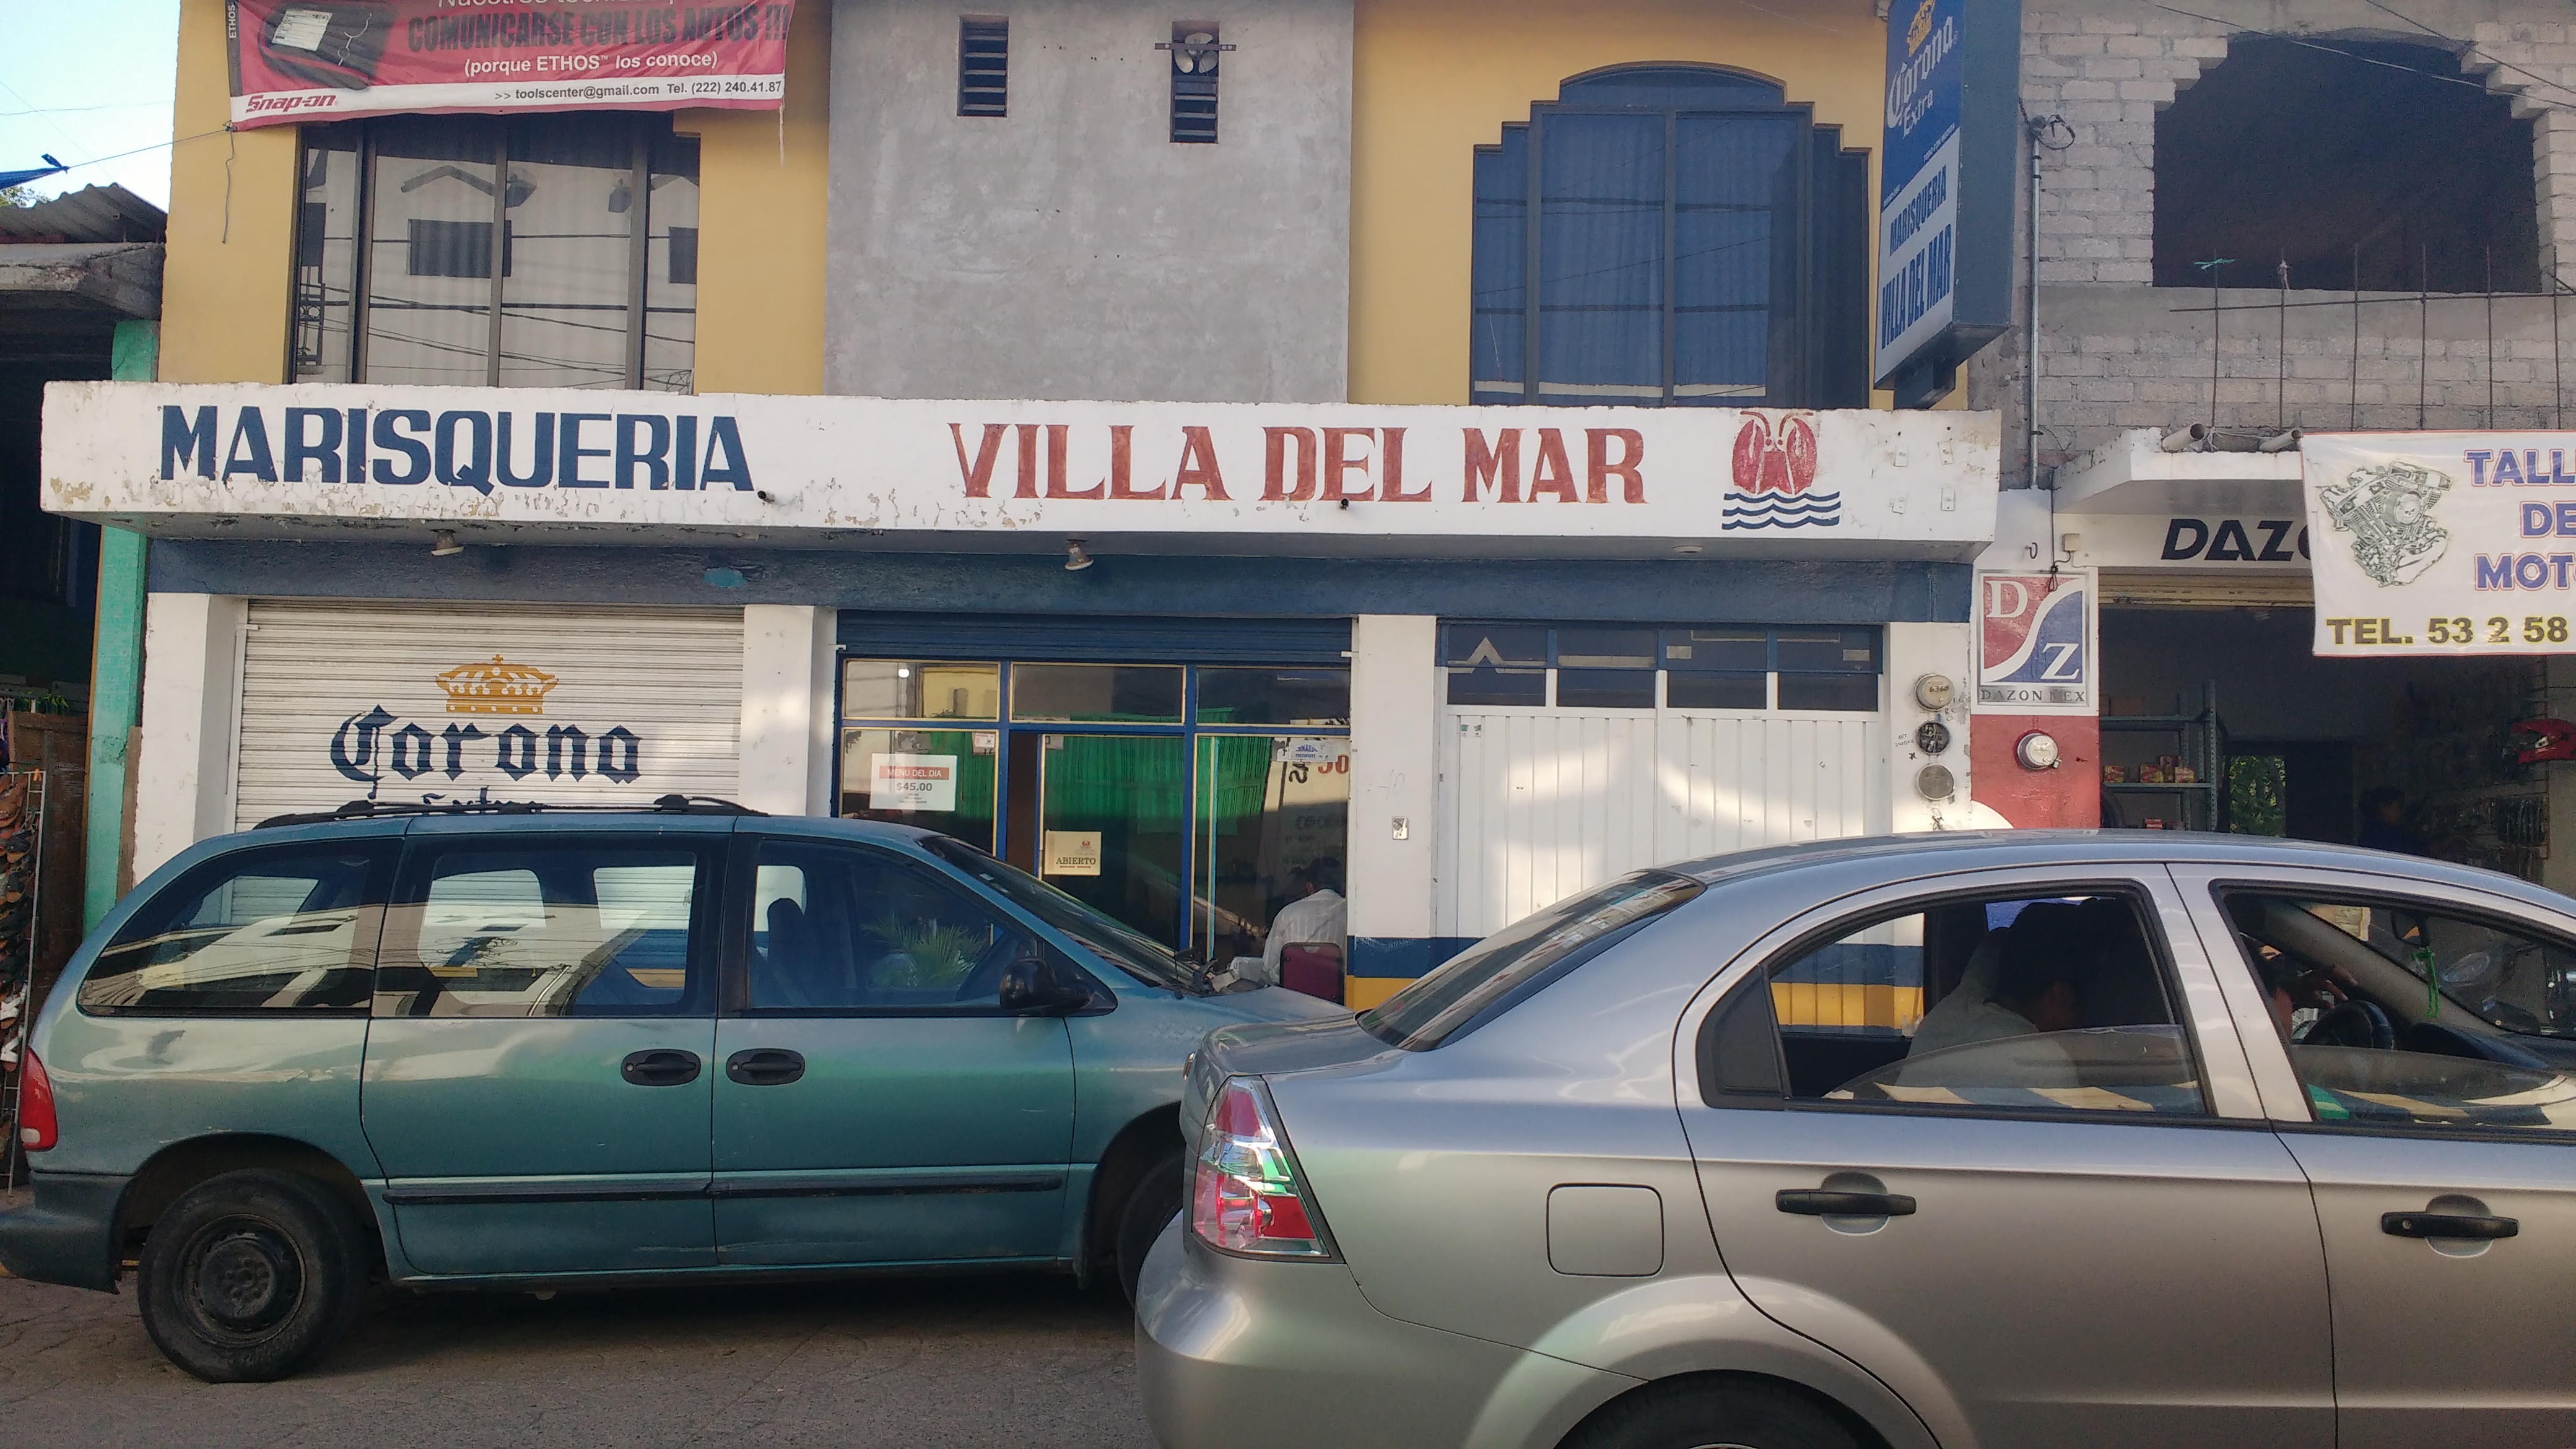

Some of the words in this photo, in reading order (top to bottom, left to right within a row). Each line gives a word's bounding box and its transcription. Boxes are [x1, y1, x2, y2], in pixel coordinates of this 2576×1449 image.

[227, 4, 237, 38] ETHOS
[408, 11, 574, 52] COMUNICARSE
[580, 9, 629, 46] CON
[634, 7, 677, 45] LOS
[681, 4, 759, 41] AUTOS
[465, 59, 531, 77] (porque
[616, 54, 641, 69] los
[646, 50, 718, 69] conoce)
[1887, 17, 1953, 129] Corona
[246, 95, 336, 113] Snap-on
[516, 84, 659, 99] toolscenter@gmail.com
[667, 83, 687, 94] Tel.
[691, 82, 721, 95] (222)
[724, 80, 781, 93] 240.41.87
[1903, 89, 1933, 139] Extra
[1890, 165, 1947, 256] MARISQUERIA
[1882, 266, 1907, 350] VILLA
[1908, 248, 1925, 328] DEL
[1926, 224, 1951, 311] MAR
[161, 405, 755, 497] MARISQUERIA
[946, 423, 1235, 501] VILLA
[1258, 427, 1432, 502] DEL
[1461, 428, 1650, 503] MAR
[2464, 448, 2576, 487] TALL
[2474, 552, 2576, 591] MOT
[1985, 580, 2028, 618] D
[2326, 617, 2414, 645] TEL.
[2427, 617, 2474, 644] 53
[2487, 617, 2509, 643] 2
[2523, 616, 2569, 643] 58
[2040, 643, 2079, 679] Z
[1981, 689, 2043, 701] DAZON
[330, 704, 643, 799] Corona
[896, 782, 933, 792] $45.00
[913, 769, 927, 777] DEL
